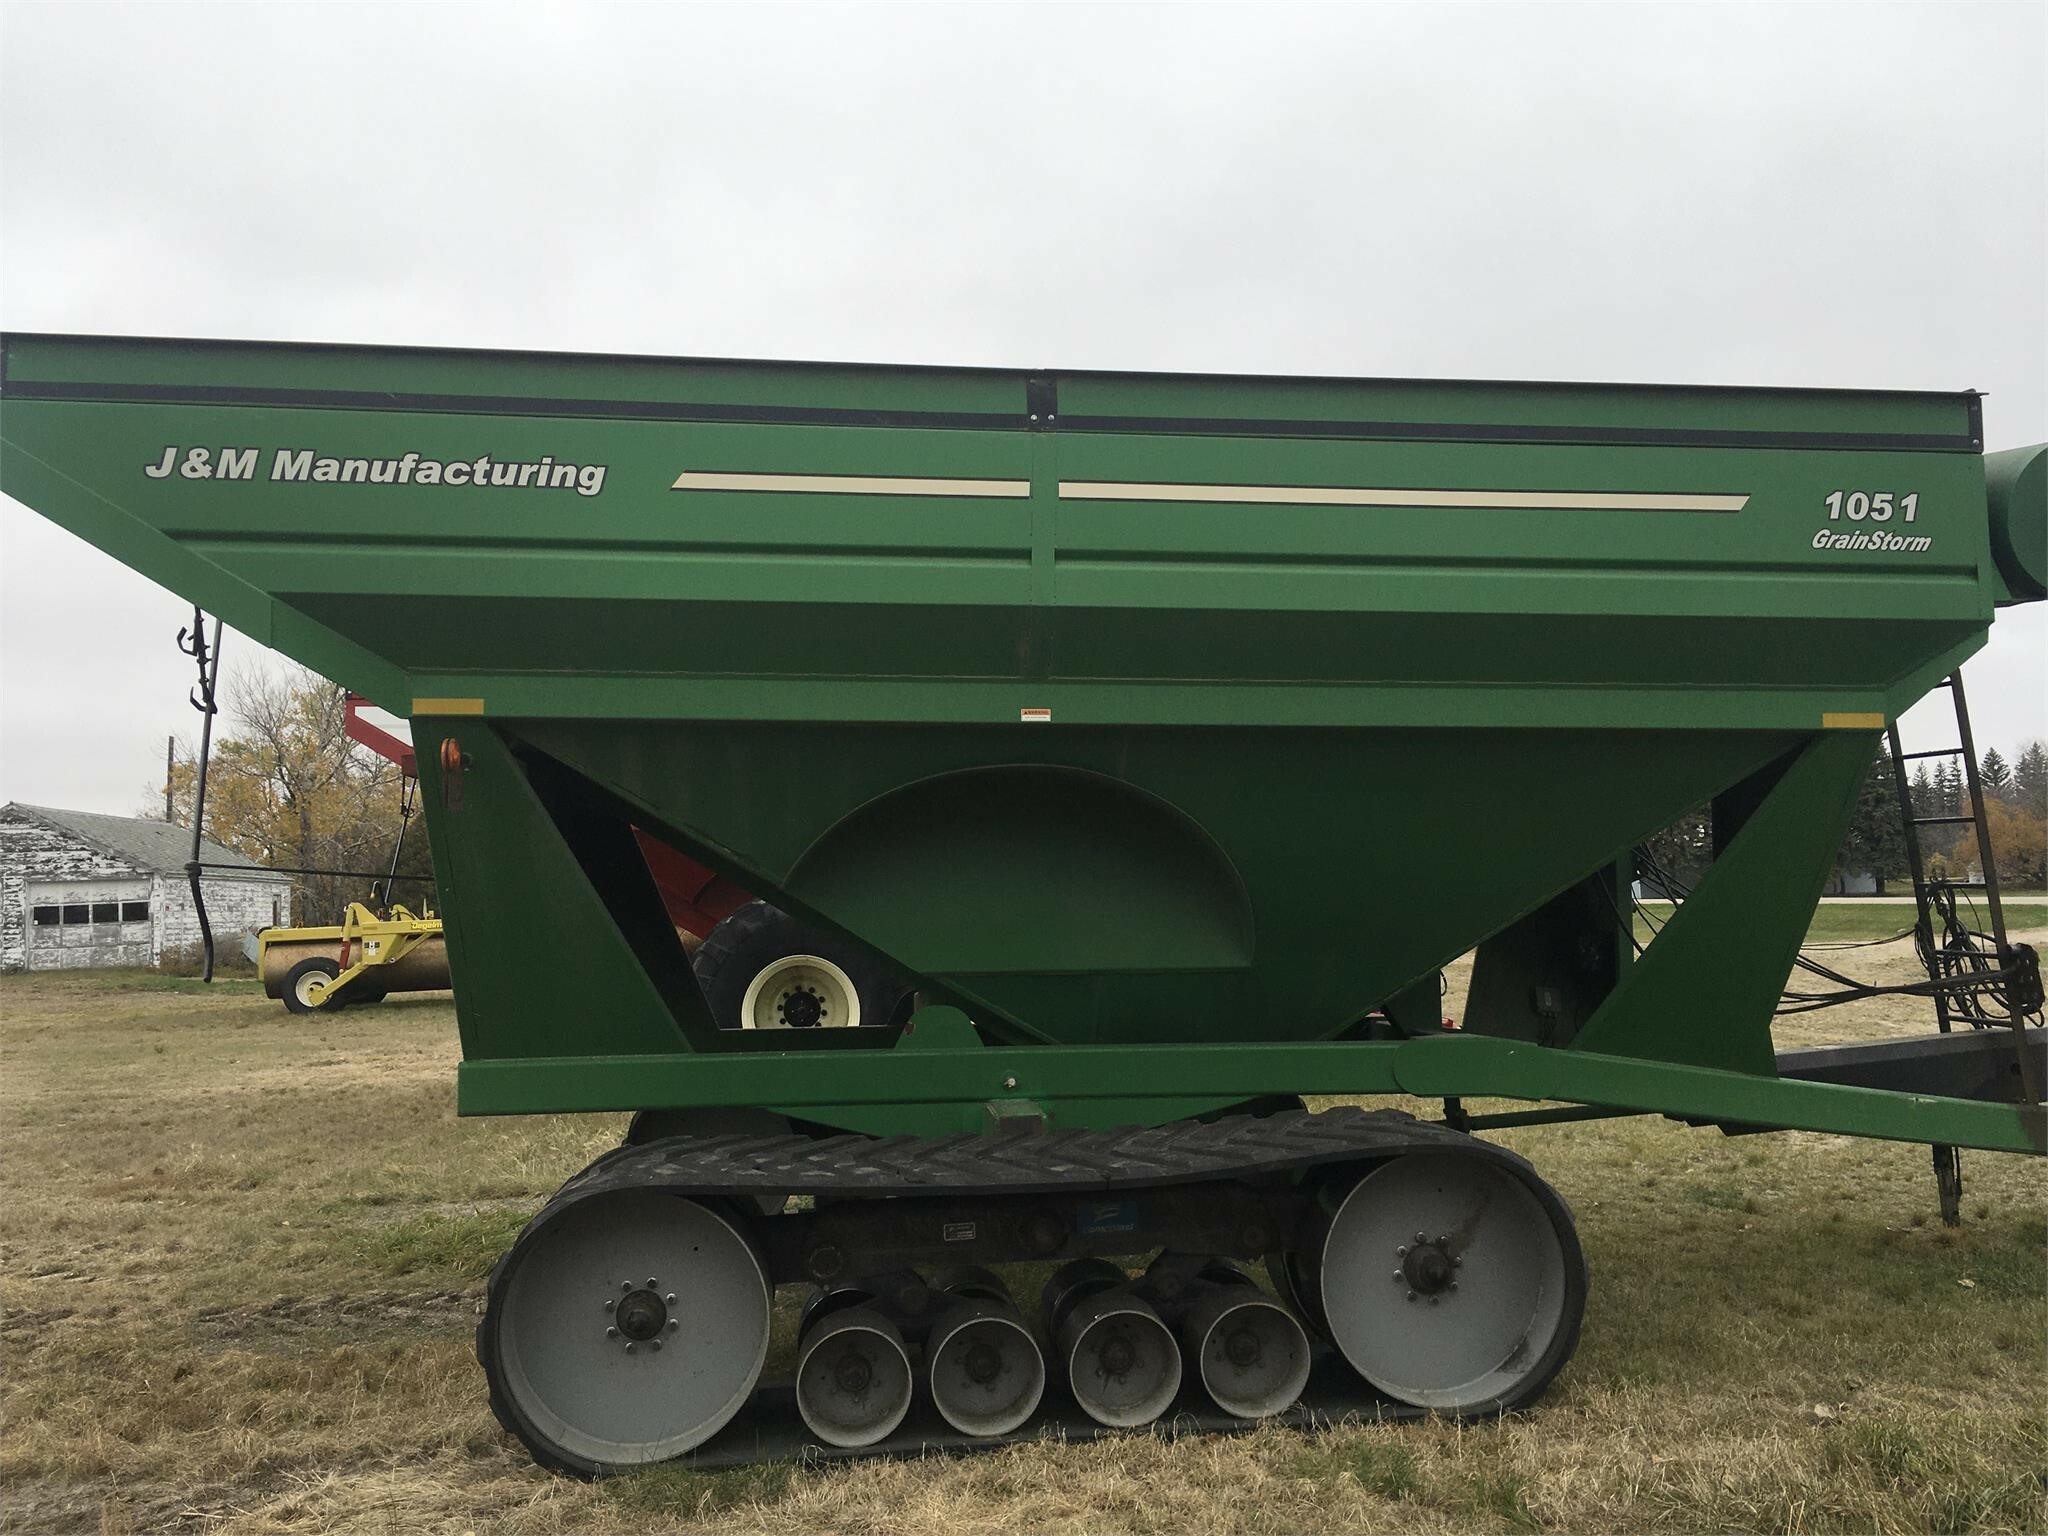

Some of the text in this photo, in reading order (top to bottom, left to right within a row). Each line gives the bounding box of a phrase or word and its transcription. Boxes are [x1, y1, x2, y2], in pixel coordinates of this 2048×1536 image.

[270, 448, 607, 497] Manufacturing
[1825, 490, 1919, 522] 1051
[1811, 528, 1933, 552] GrainStorm
